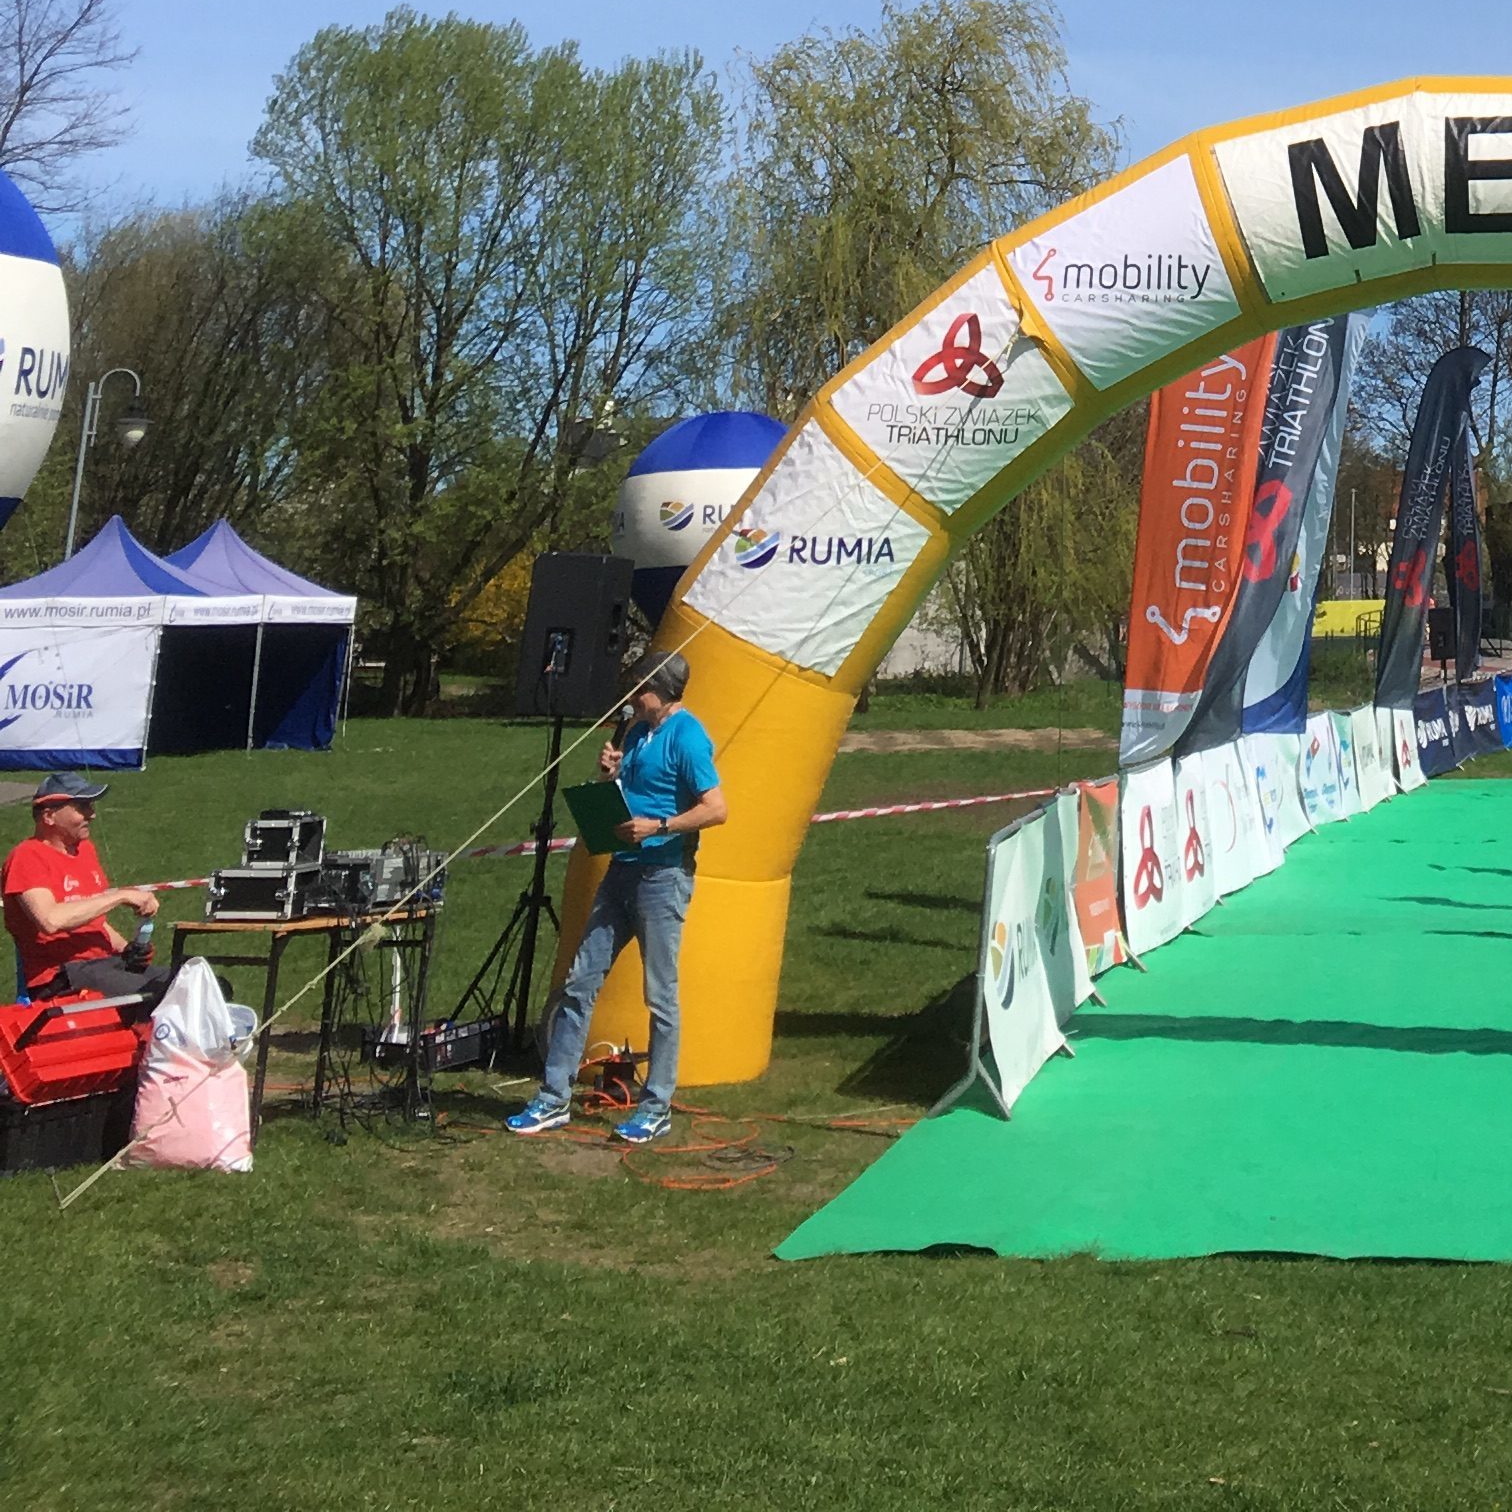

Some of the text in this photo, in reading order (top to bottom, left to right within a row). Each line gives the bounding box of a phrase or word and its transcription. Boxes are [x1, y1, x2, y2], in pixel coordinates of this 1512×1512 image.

[1061, 293, 1186, 303] CARSHARING
[1268, 317, 1335, 469] TRIATHLON
[1211, 389, 1247, 593] CARSHARING
[787, 536, 895, 566] RUMIA
[4, 602, 151, 620] www.mosir.rumia.pl
